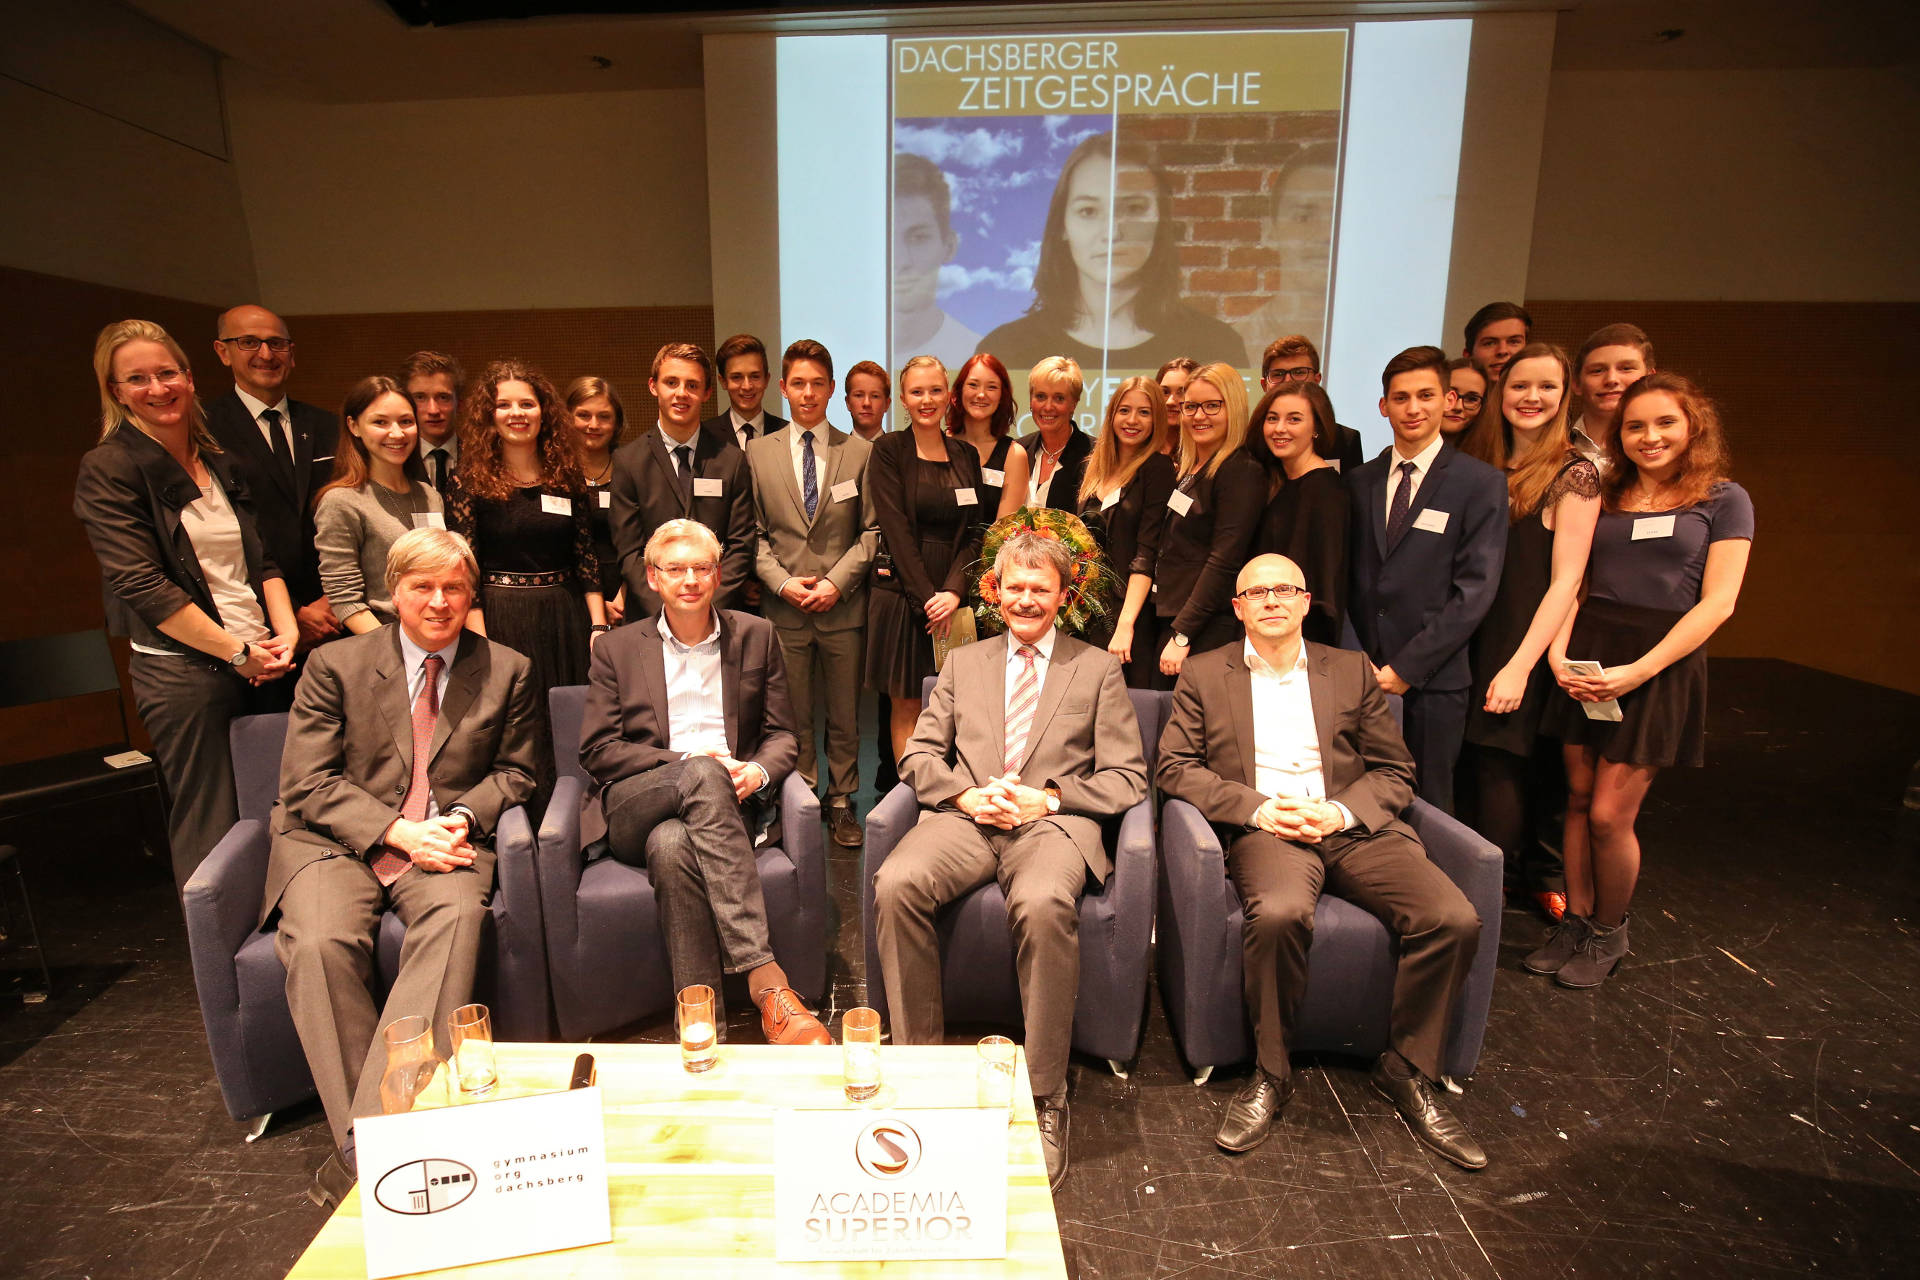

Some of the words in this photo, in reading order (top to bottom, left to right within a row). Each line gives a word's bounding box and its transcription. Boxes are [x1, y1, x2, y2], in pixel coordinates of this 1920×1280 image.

[899, 42, 1119, 73] DACHSBERGER
[958, 65, 1262, 110] ZEITGESPRÄCHE
[493, 1145, 589, 1169] gymnasium
[494, 1170, 522, 1181] org
[495, 1173, 584, 1194] dachsberg
[809, 1191, 966, 1214] ACADEMIA
[804, 1216, 973, 1243] SUPERIOR
